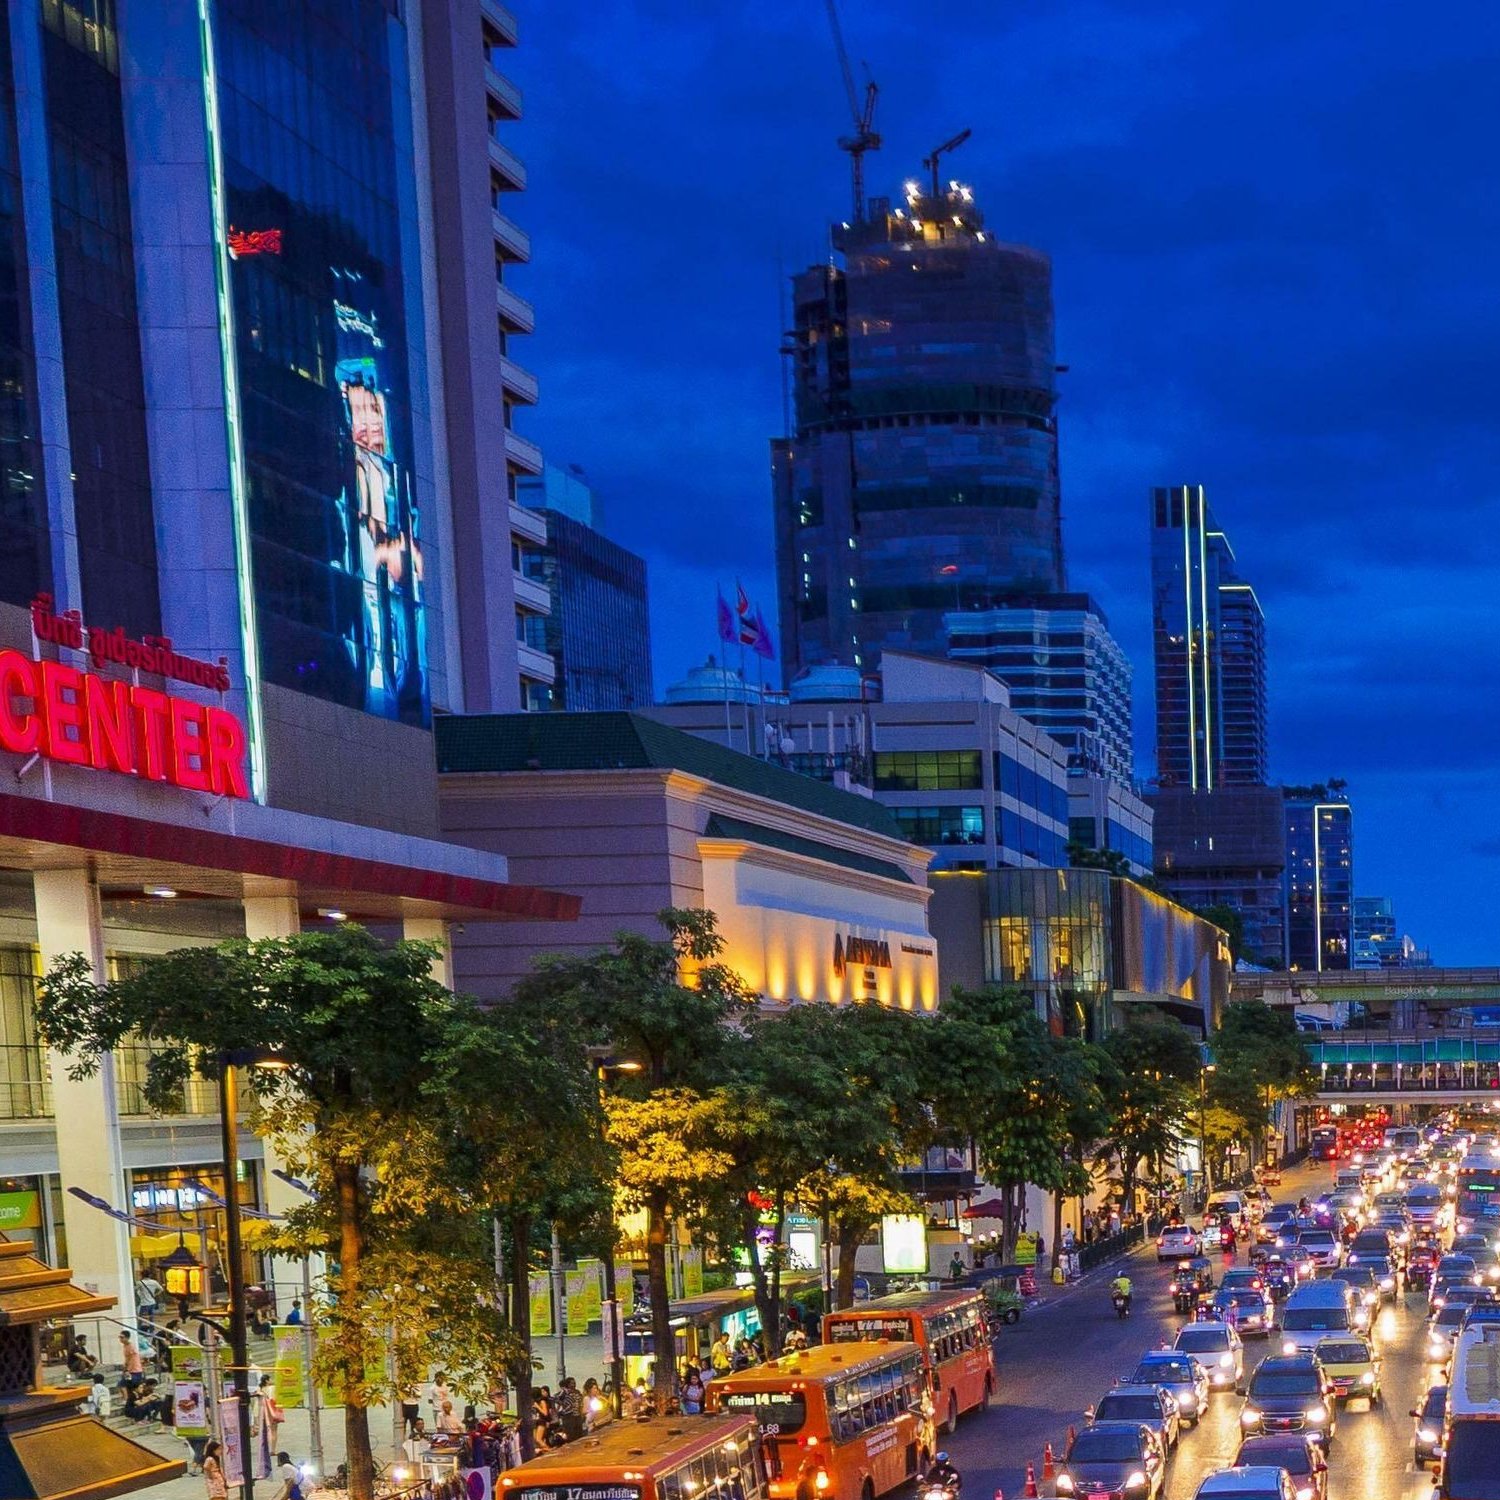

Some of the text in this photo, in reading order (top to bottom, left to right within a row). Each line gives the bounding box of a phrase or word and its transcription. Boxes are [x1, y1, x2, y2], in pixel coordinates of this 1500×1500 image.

[0, 649, 248, 798] CENTER
[755, 1393, 769, 1405] 14
[567, 1488, 581, 1500] 17
